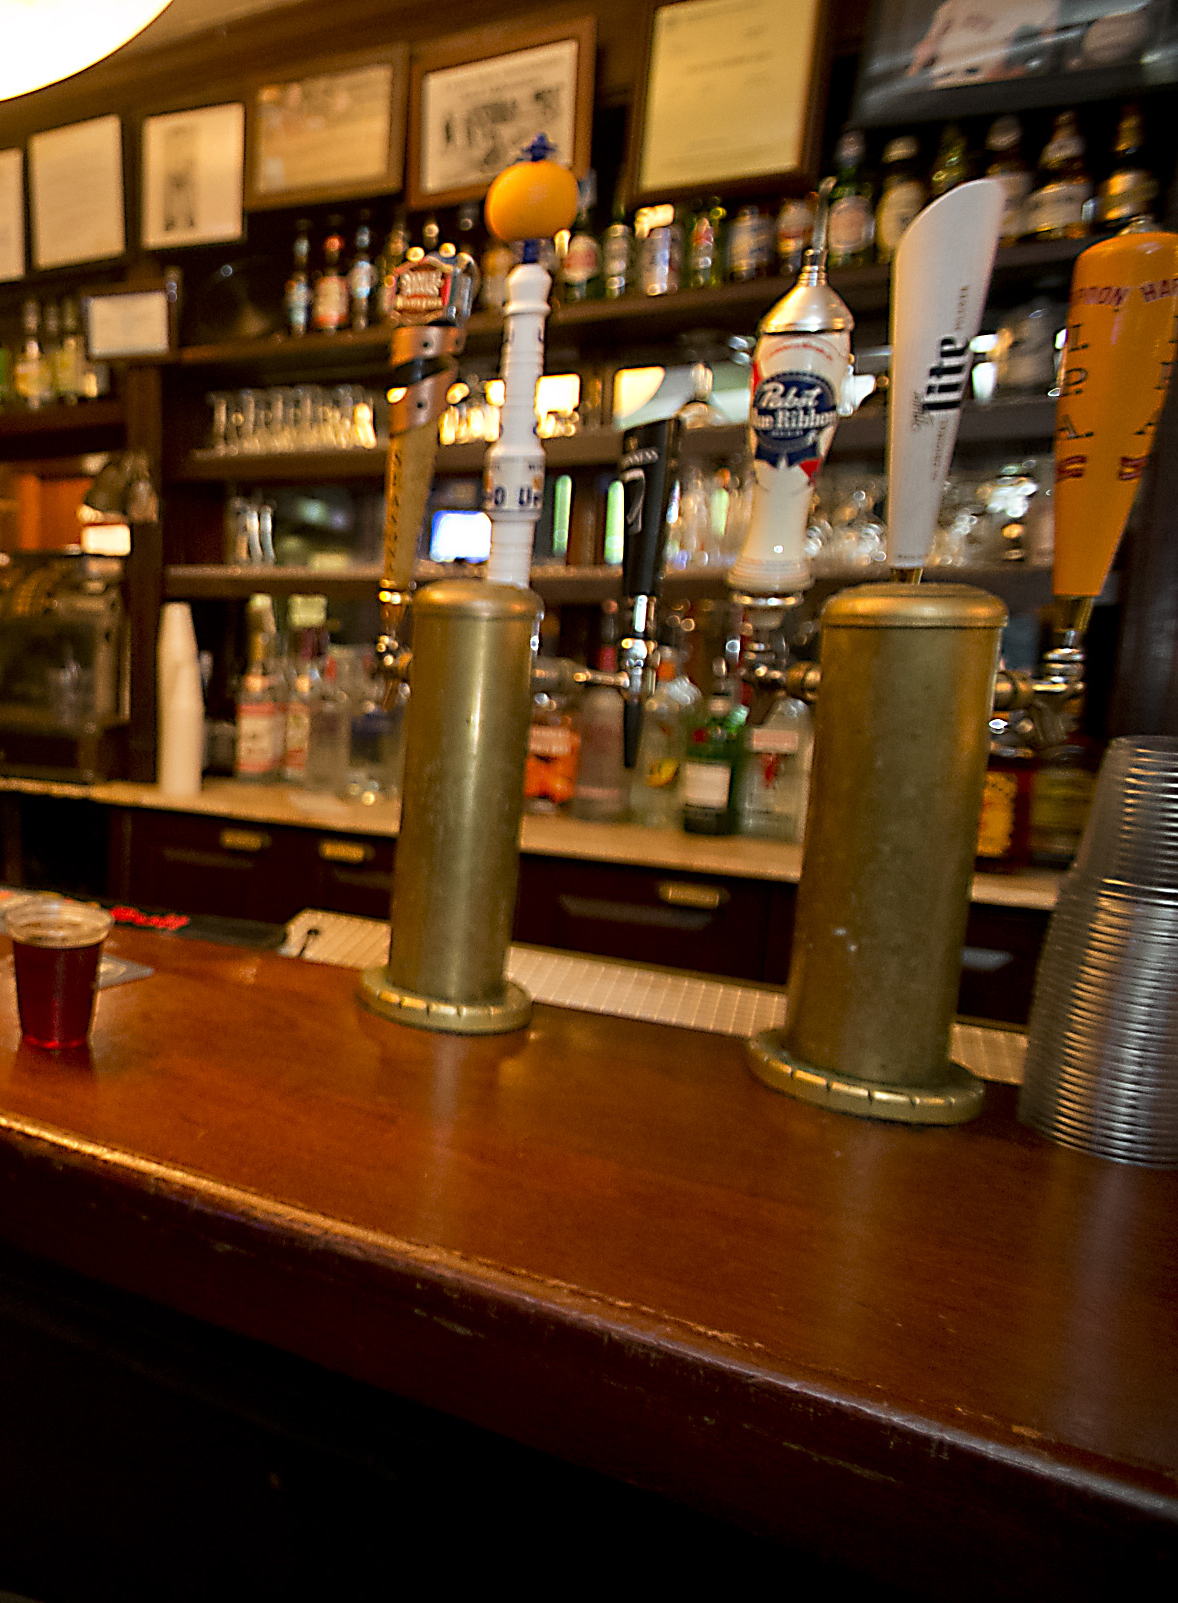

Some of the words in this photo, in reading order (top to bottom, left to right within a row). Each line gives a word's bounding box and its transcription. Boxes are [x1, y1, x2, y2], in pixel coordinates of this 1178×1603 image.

[922, 336, 970, 412] lite
[759, 381, 823, 410] Pabst
[775, 407, 838, 429] Ribbon
